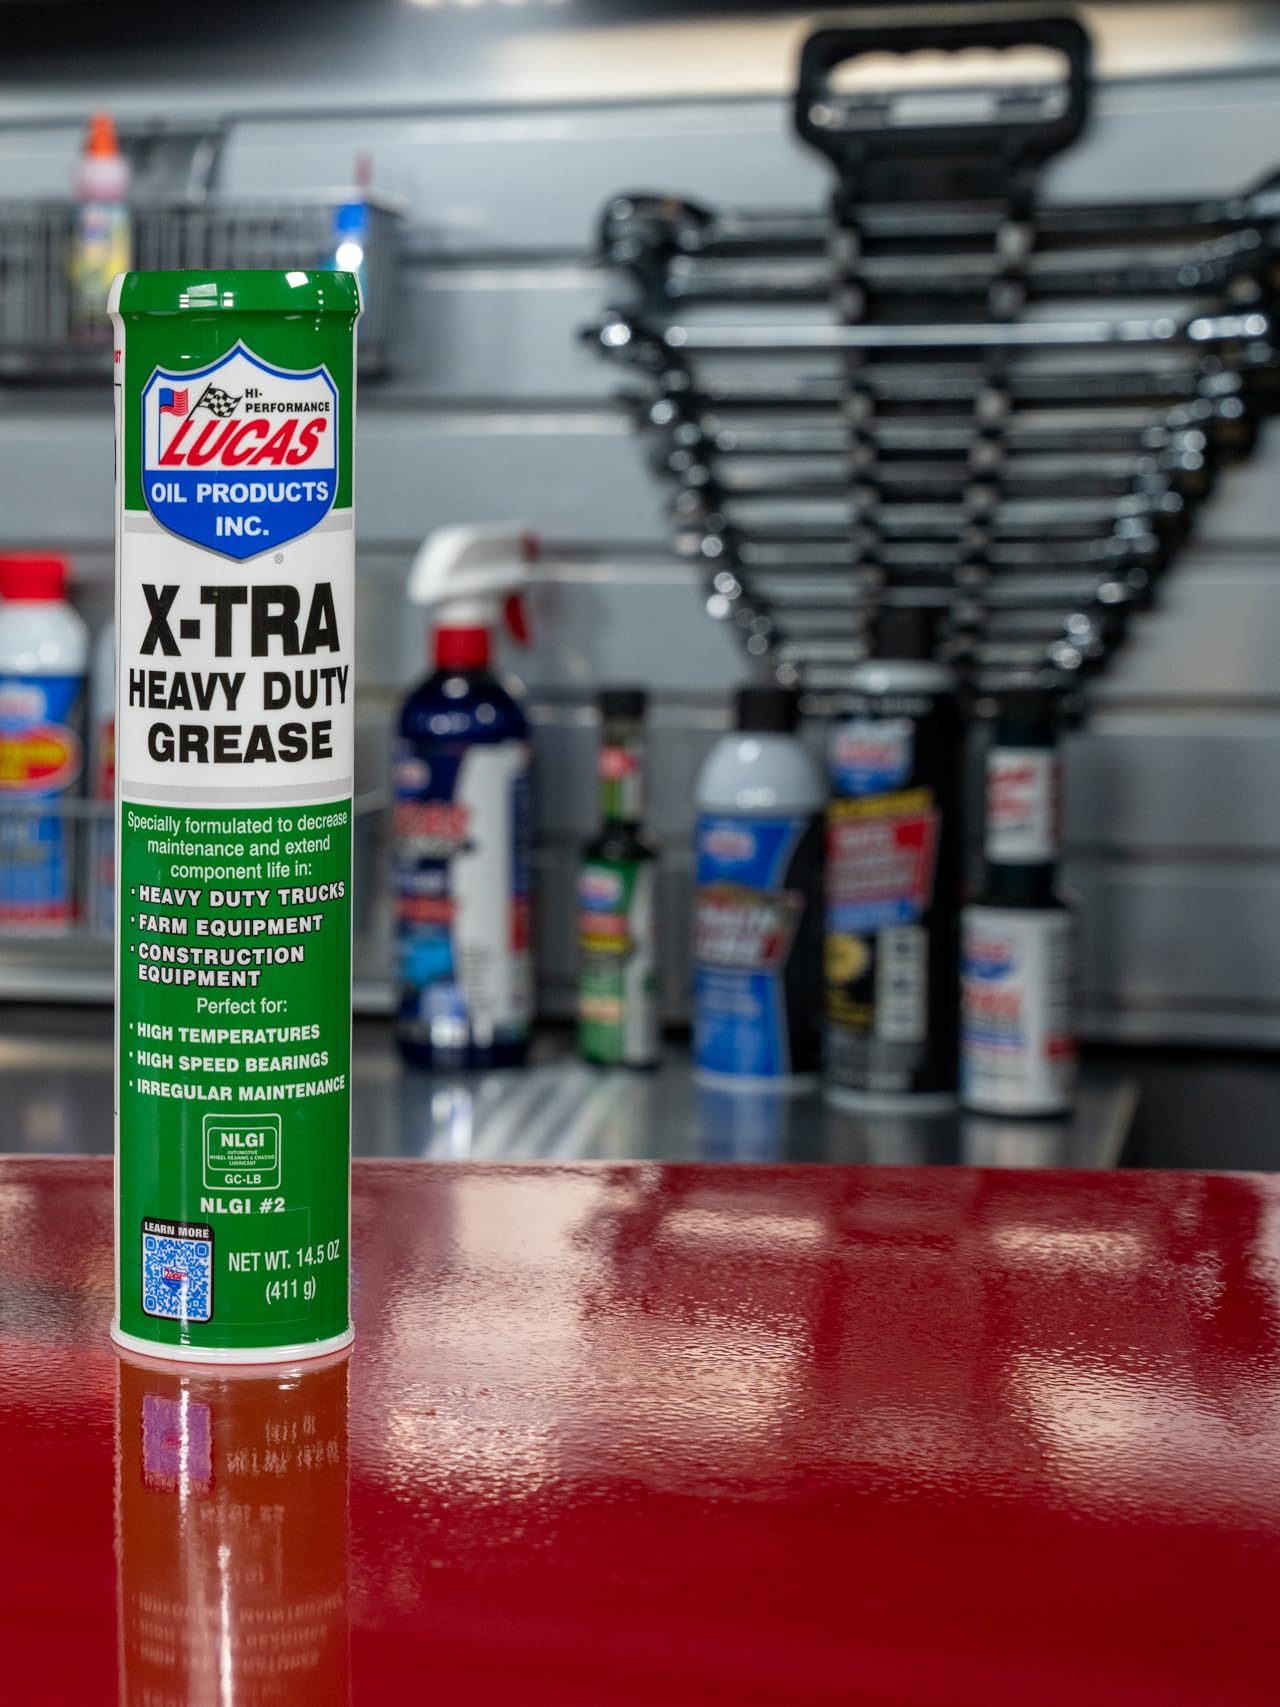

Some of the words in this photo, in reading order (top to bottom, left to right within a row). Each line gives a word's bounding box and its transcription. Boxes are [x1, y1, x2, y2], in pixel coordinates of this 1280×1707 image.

[245, 388, 263, 398] HI-
[245, 402, 330, 413] PERFORMANCE
[158, 418, 327, 466] LUCAS
[151, 483, 187, 503] OIL
[197, 482, 328, 503] PRODUCTS
[216, 516, 269, 536] INC.
[139, 582, 340, 657] X-TRA
[129, 668, 246, 711] HEAVY
[264, 665, 348, 710] DUTY
[148, 720, 332, 763] GREASE
[128, 811, 181, 836] Specially
[185, 816, 272, 833] formulated
[278, 817, 292, 832] to
[297, 811, 347, 831] decrease
[148, 838, 244, 856] maintenance
[249, 839, 280, 856] and
[285, 834, 330, 854] extend
[171, 863, 262, 882] component
[267, 862, 290, 877] life
[295, 860, 312, 876] in:
[139, 885, 201, 906] HEAVY
[209, 889, 270, 907] DUTY
[278, 881, 345, 905] TRUCKS
[139, 913, 188, 935] FARM
[196, 914, 323, 937] EQUIPMENT
[138, 943, 304, 966] CONSTRUCTION
[138, 965, 261, 987] EQUIPMENT
[196, 997, 256, 1014] Perfect
[261, 998, 287, 1013] for:
[137, 1022, 173, 1041] HIGH
[178, 1024, 320, 1044] TEMPERATURES
[137, 1050, 173, 1069] HIGH
[179, 1056, 239, 1072] SPEED
[245, 1051, 329, 1072] BEARINGS
[137, 1078, 232, 1100] IRREGULAR
[239, 1074, 345, 1100] MAINTENANCE
[221, 1133, 265, 1147] NLGI
[225, 1174, 261, 1184] GC-LB
[200, 1198, 251, 1214] NLGI
[260, 1197, 285, 1213] #2
[144, 1221, 175, 1236] LEARN
[178, 1226, 209, 1238] MORE
[228, 1252, 261, 1271] NET
[265, 1250, 291, 1270] WT.
[296, 1242, 324, 1267] 14.5
[327, 1239, 340, 1259] OZ
[266, 1281, 297, 1304] (411
[304, 1276, 317, 1300] g)
